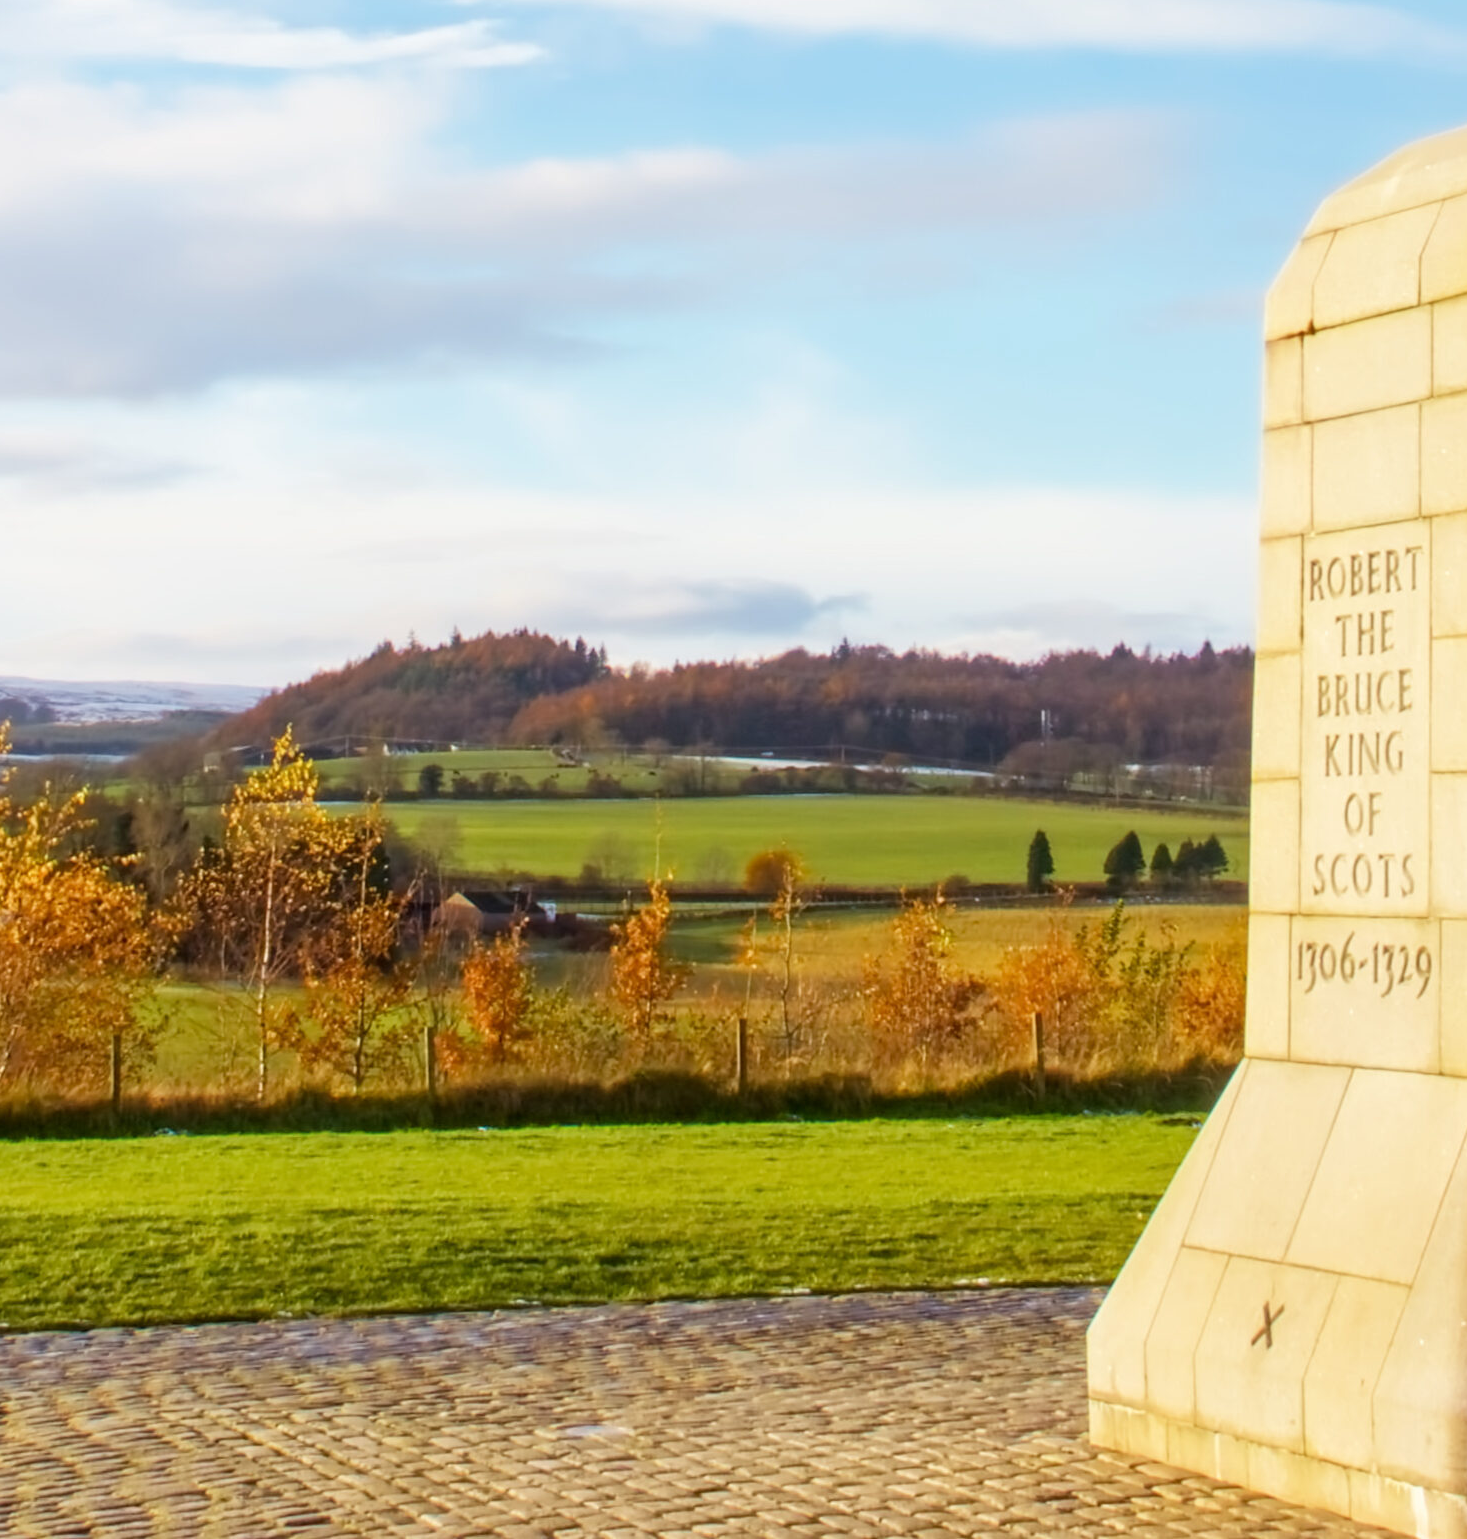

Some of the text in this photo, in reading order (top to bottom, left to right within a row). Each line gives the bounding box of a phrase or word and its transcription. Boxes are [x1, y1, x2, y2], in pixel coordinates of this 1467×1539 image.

[1309, 546, 1424, 601] ROBERT
[1335, 610, 1394, 657] THE
[1317, 668, 1413, 718] BRUCE
[1325, 731, 1404, 777] KING
[1344, 792, 1382, 837] OF
[1313, 853, 1414, 898] SCOTS
[1297, 930, 1432, 999] 1306-1329
